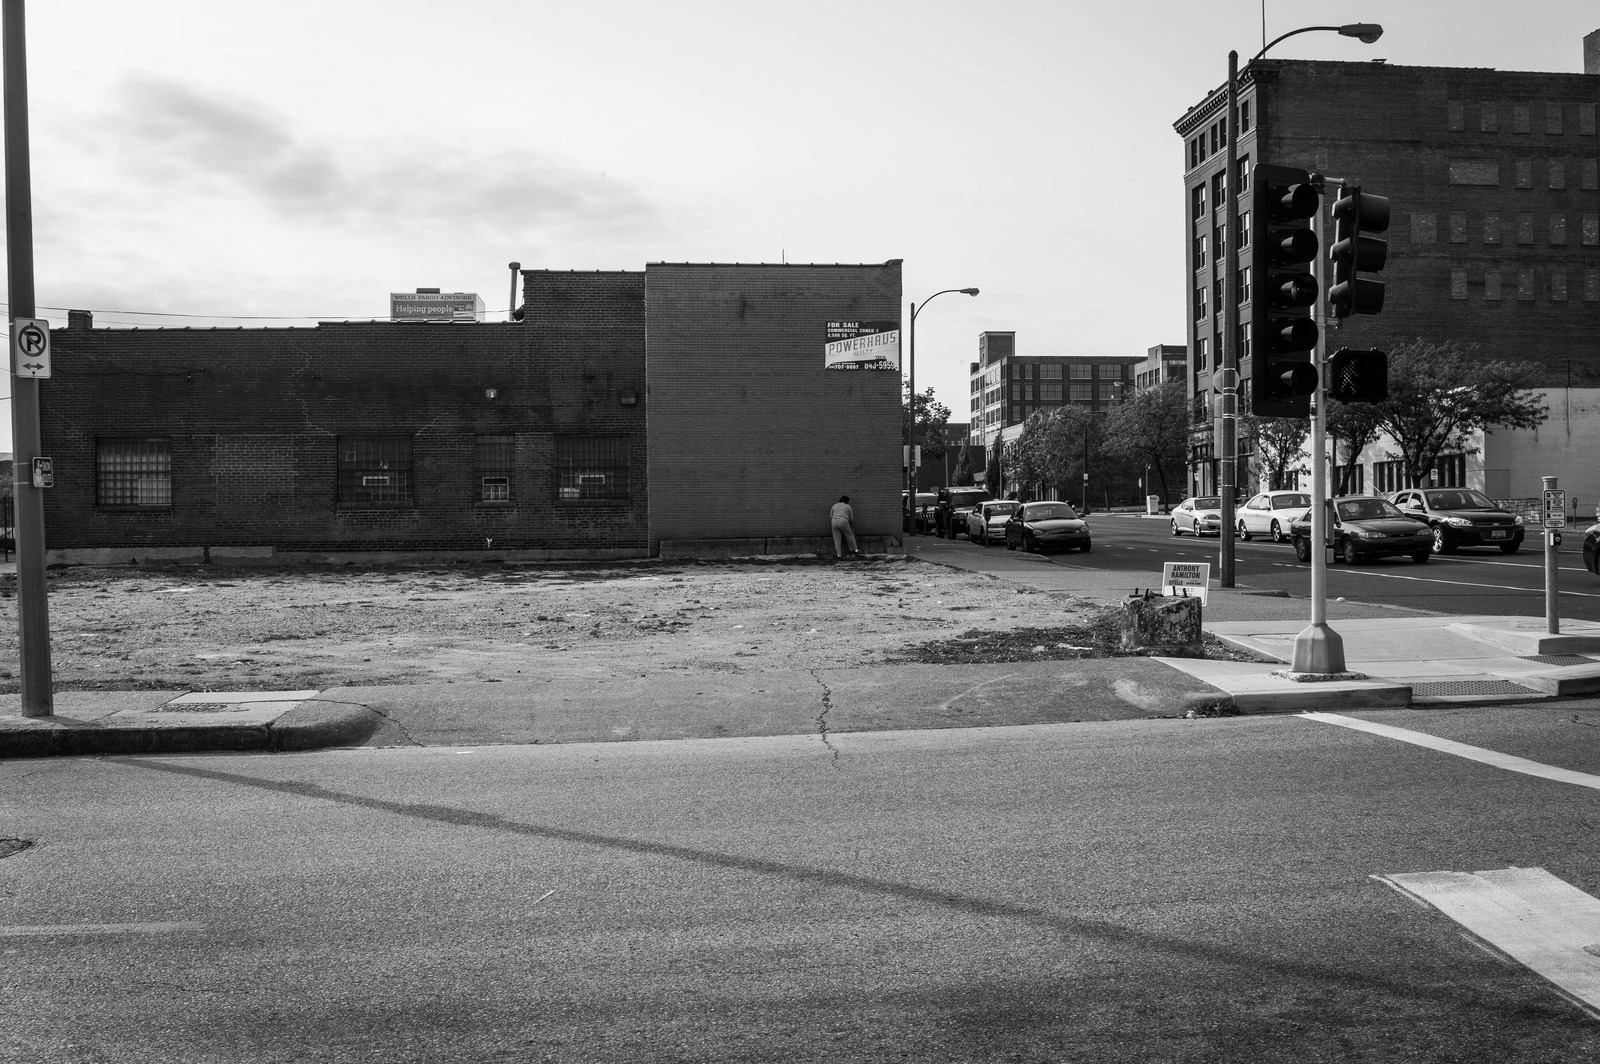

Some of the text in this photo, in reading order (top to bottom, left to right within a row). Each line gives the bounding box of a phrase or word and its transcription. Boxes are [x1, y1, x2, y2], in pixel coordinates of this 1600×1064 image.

[395, 304, 426, 314] Helping
[427, 304, 453, 314] people
[828, 332, 896, 355] POWERHAUS
[1172, 564, 1200, 572] ANTHONY
[1171, 571, 1201, 579] HAMILTON
